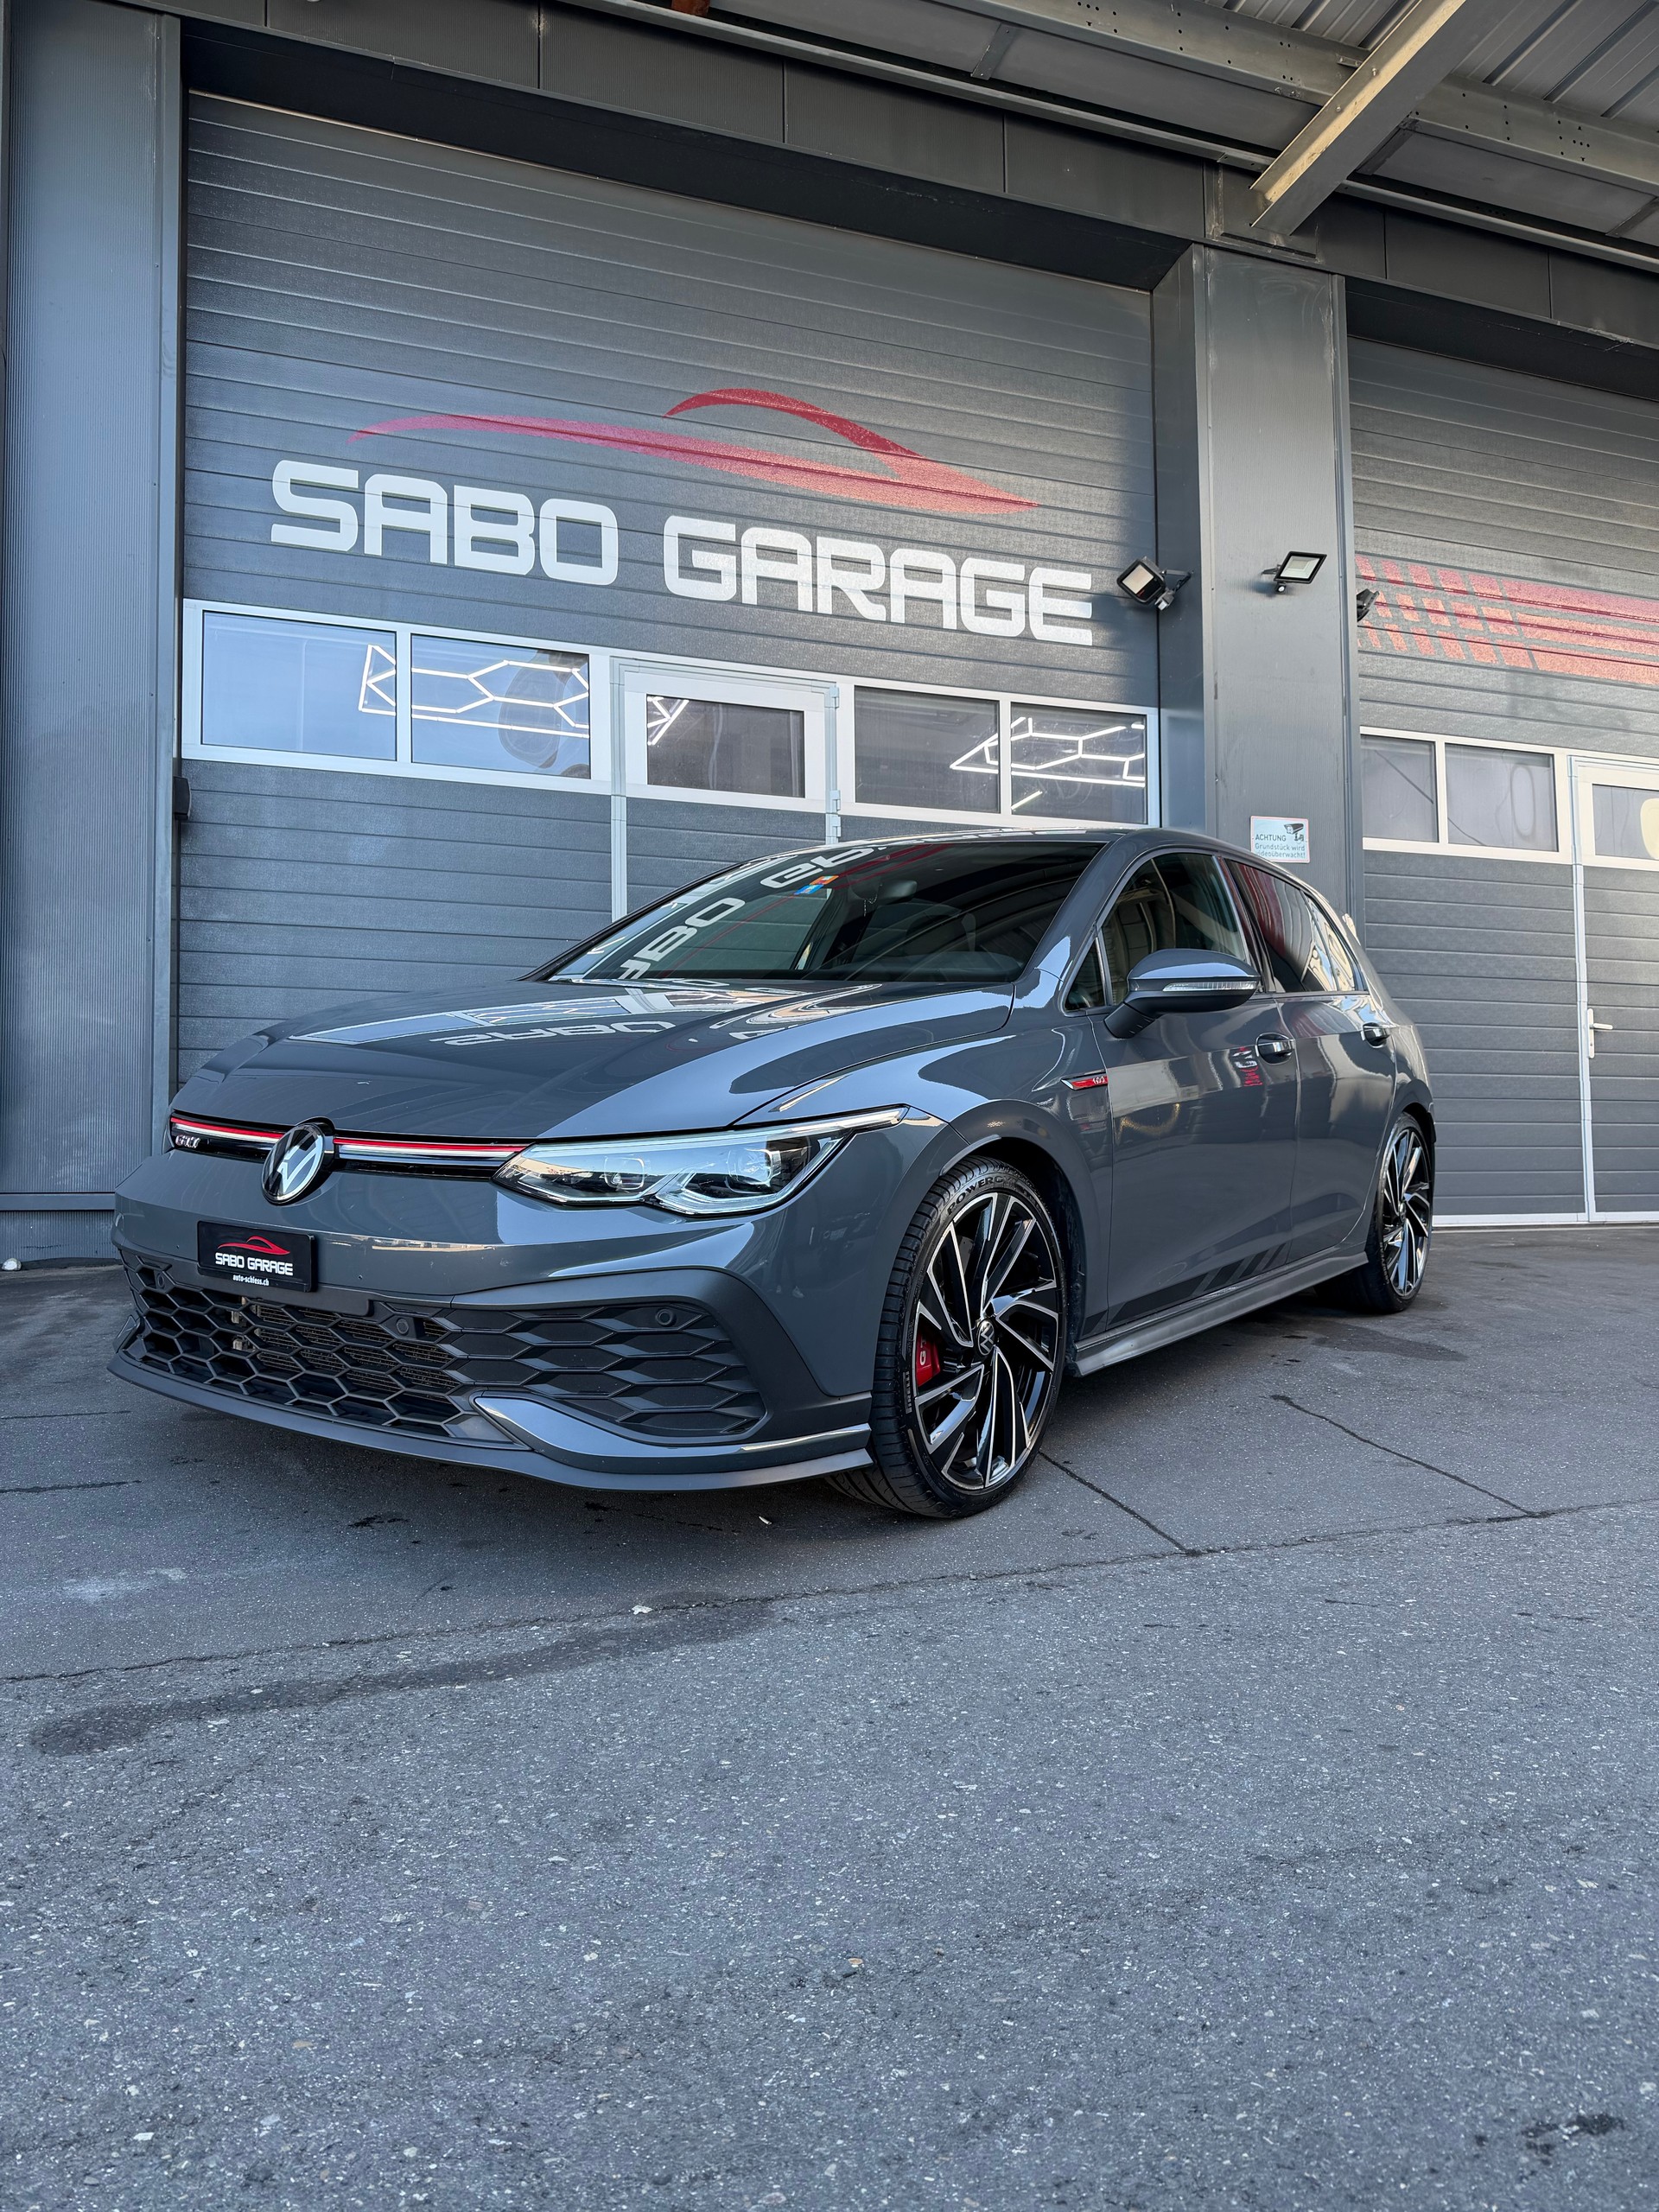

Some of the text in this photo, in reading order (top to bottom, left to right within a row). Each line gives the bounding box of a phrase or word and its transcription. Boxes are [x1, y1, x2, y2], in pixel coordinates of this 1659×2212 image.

[271, 460, 1093, 645] SABO GARAGE
[1255, 842, 1290, 851] Grundstück
[215, 1252, 294, 1276] SABO GARAGE
[232, 1274, 270, 1287] auto-schiess.ch
